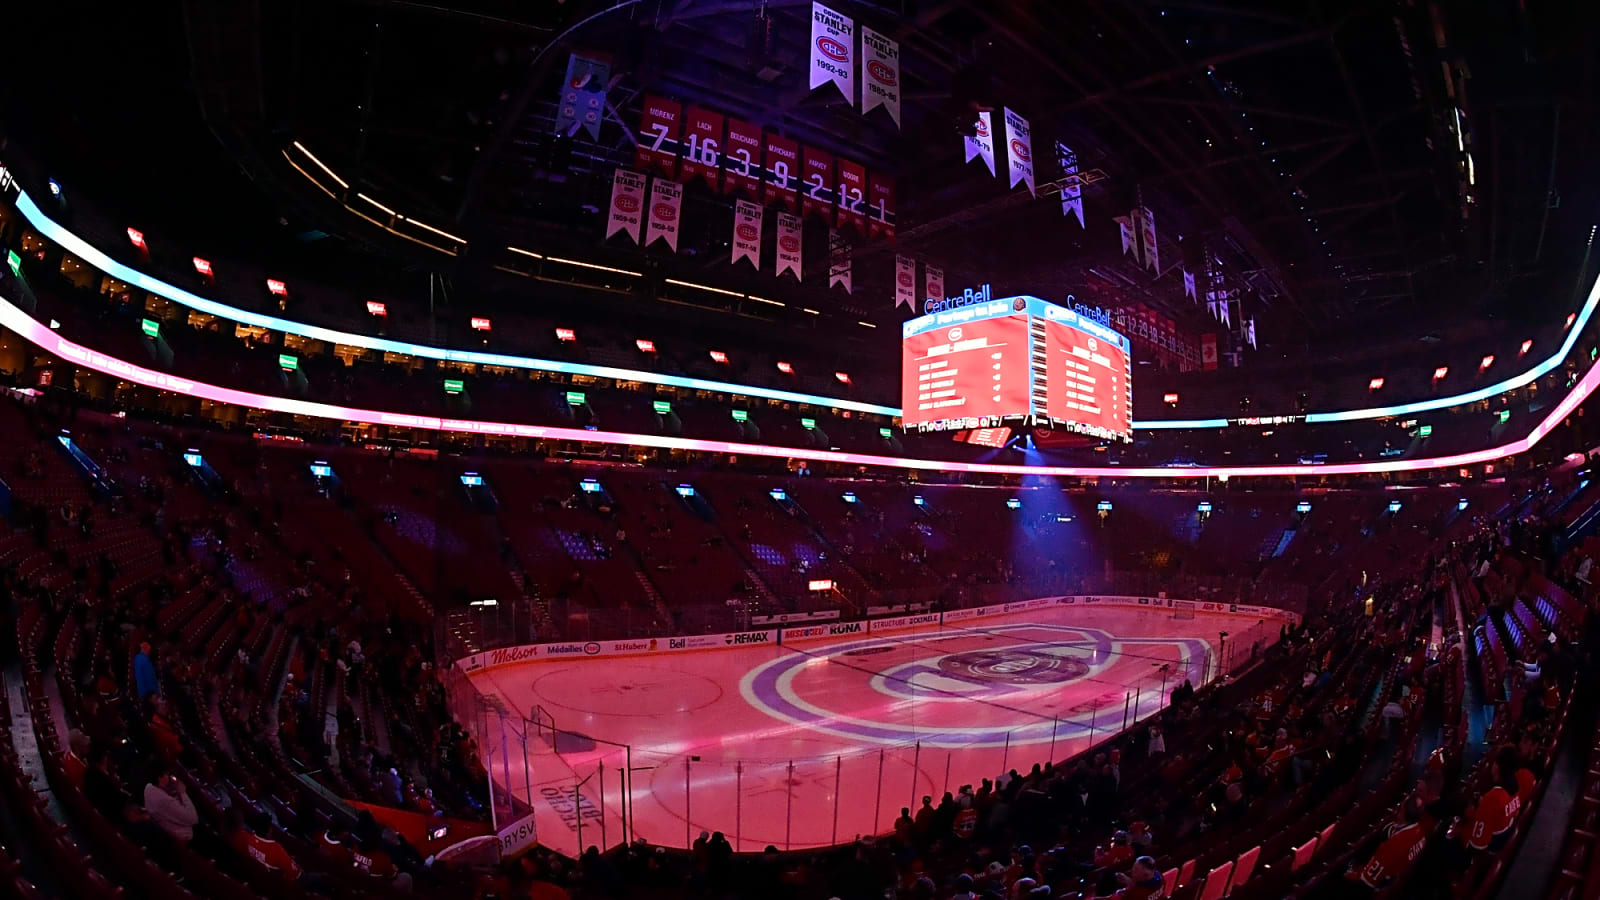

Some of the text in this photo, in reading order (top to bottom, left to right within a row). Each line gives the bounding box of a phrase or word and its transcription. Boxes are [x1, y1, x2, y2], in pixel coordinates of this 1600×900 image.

[814, 11, 853, 36] STANLEY
[823, 8, 844, 22] COUPE
[826, 27, 840, 36] CUP
[864, 35, 898, 59] STANLEY
[816, 59, 848, 79] 1992-93
[650, 107, 675, 120] MORENZ
[697, 121, 712, 132] LACH
[651, 123, 669, 152] 7
[730, 131, 758, 147] BOUCHARD
[687, 133, 718, 167] 16
[734, 148, 750, 177] 3
[808, 159, 827, 170] HARVEY
[616, 176, 645, 190] STANLEY
[774, 161, 789, 189] 9
[654, 185, 681, 198] STANLEY
[810, 173, 824, 202] 2
[839, 184, 864, 214] 12
[737, 206, 762, 219] STANLEY
[879, 199, 886, 224] 1
[830, 624, 862, 635] RONA
[547, 645, 583, 654] Médailles
[669, 639, 686, 649] Bell
[491, 647, 537, 664] Molson
[1473, 821, 1485, 838] 13
[1367, 861, 1384, 881] 21
